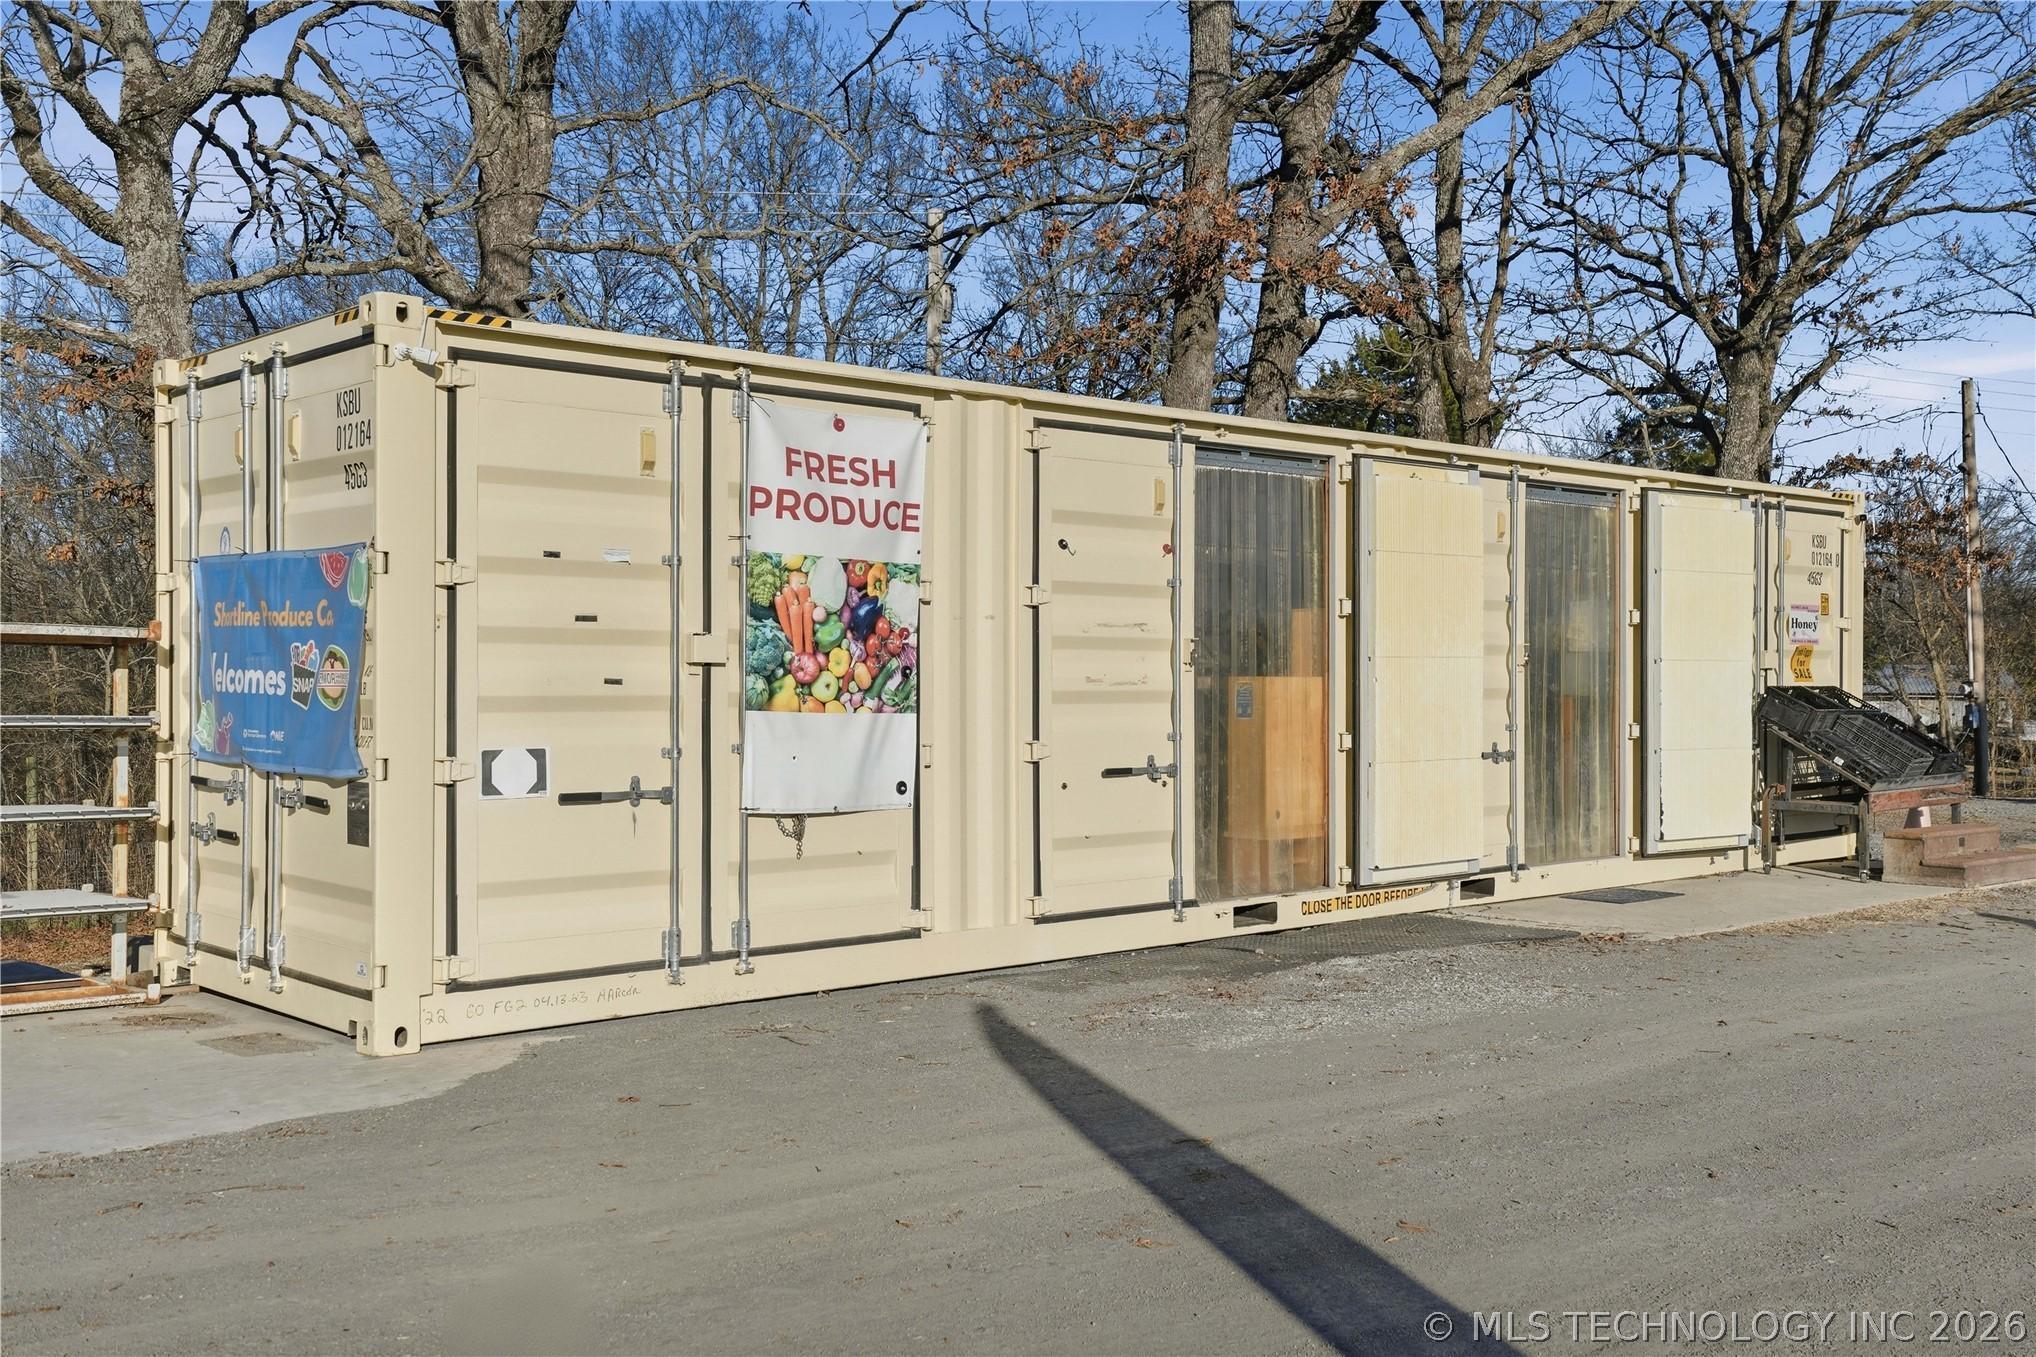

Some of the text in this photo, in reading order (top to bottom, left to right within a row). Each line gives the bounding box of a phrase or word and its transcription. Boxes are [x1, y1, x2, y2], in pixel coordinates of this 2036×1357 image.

[336, 387, 361, 419] KSBU
[336, 419, 371, 452] 012164
[343, 461, 368, 490] 45G3
[785, 446, 897, 489] FRESH
[749, 486, 921, 533] PRODUCE
[1811, 534, 1827, 549] KSBU
[1811, 551, 1833, 567] 012164
[1791, 617, 1817, 632] Honey
[292, 677, 315, 693] SNAP
[1793, 668, 1813, 679] SALE
[1301, 899, 1332, 916] CLOSE
[1335, 896, 1352, 911] THE
[1355, 892, 1380, 909] DOOR
